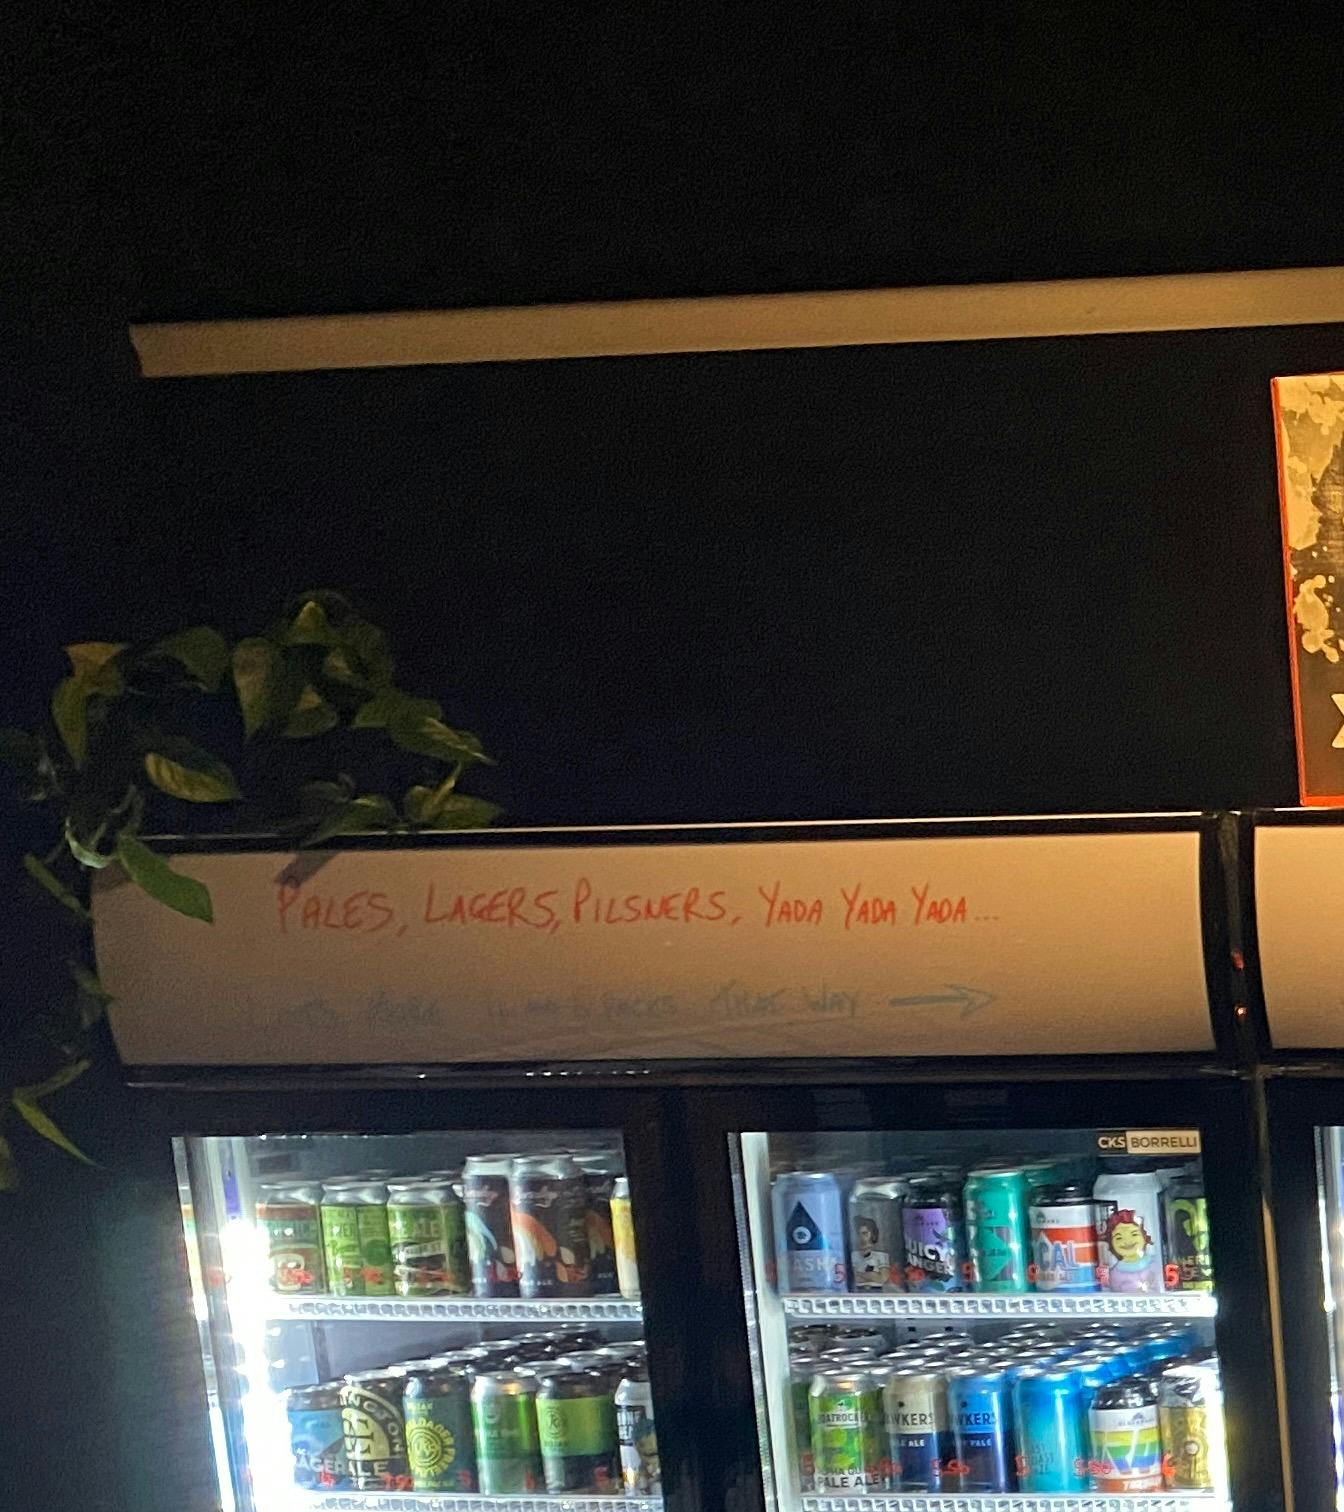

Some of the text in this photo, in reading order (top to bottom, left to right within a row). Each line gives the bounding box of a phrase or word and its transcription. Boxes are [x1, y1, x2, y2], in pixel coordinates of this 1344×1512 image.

[277, 880, 405, 937] PALES,
[425, 879, 561, 933] LAGERS,
[574, 876, 742, 925] PILSNERS,
[759, 881, 823, 927] YADA
[841, 882, 896, 929] YADA
[1097, 1136, 1198, 1149] CKS BORRELLI
